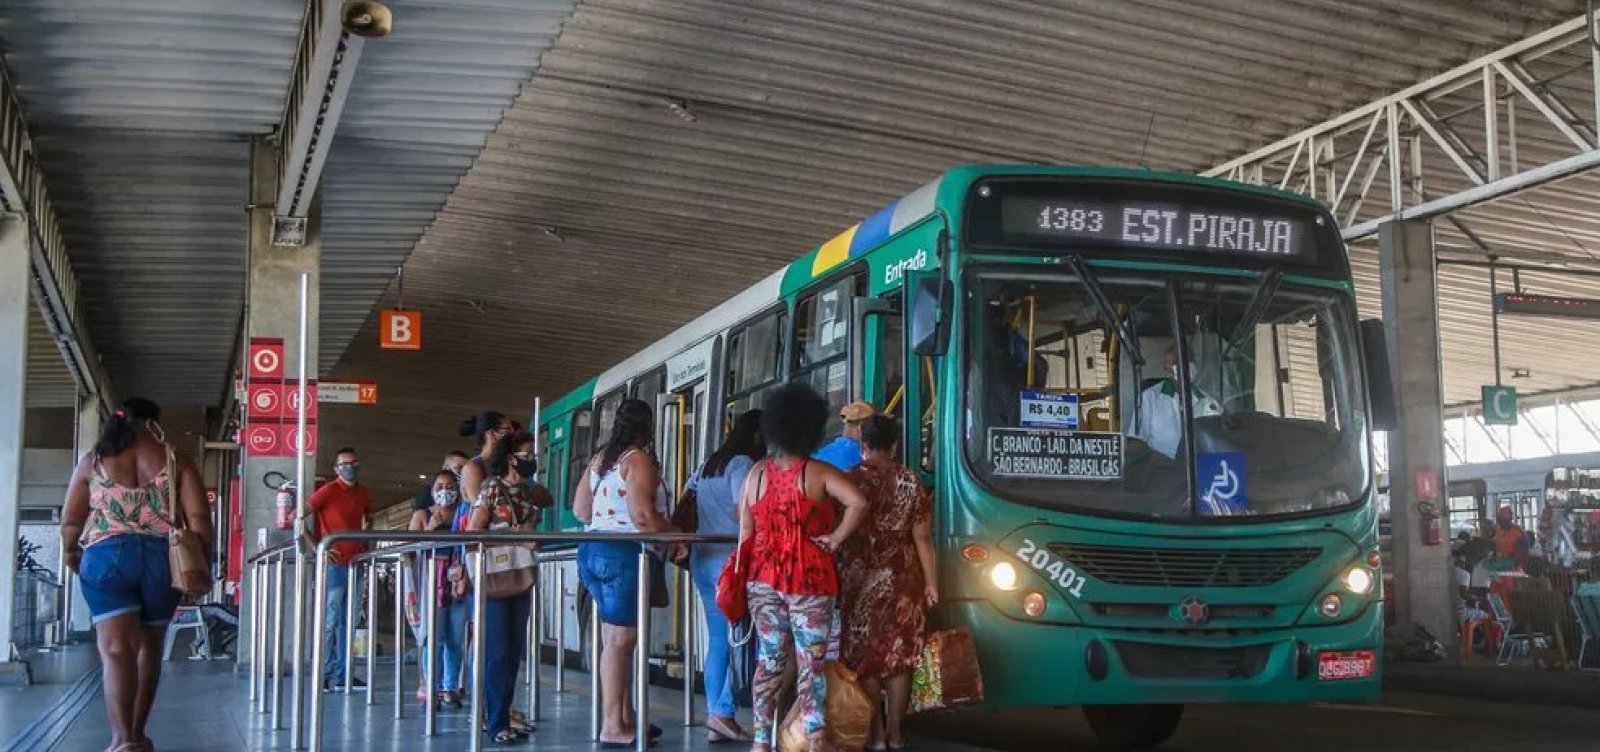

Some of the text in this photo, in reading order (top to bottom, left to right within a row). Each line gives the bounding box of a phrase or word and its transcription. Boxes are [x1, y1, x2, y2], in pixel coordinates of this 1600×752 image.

[1039, 206, 1103, 232] 1383
[885, 248, 927, 285] Entrada
[391, 315, 411, 343] B
[360, 387, 376, 399] 17
[1493, 389, 1510, 419] C
[1028, 402, 1071, 417] R$ 4,40
[1003, 436, 1041, 453] BRANCO
[1047, 437, 1069, 455] LAD.
[1069, 438, 1083, 455] DA
[993, 452, 1012, 473] SÃO
[1013, 456, 1063, 474] BERNARDO
[1069, 457, 1101, 476] BRASIL
[1016, 538, 1086, 598] 20401
